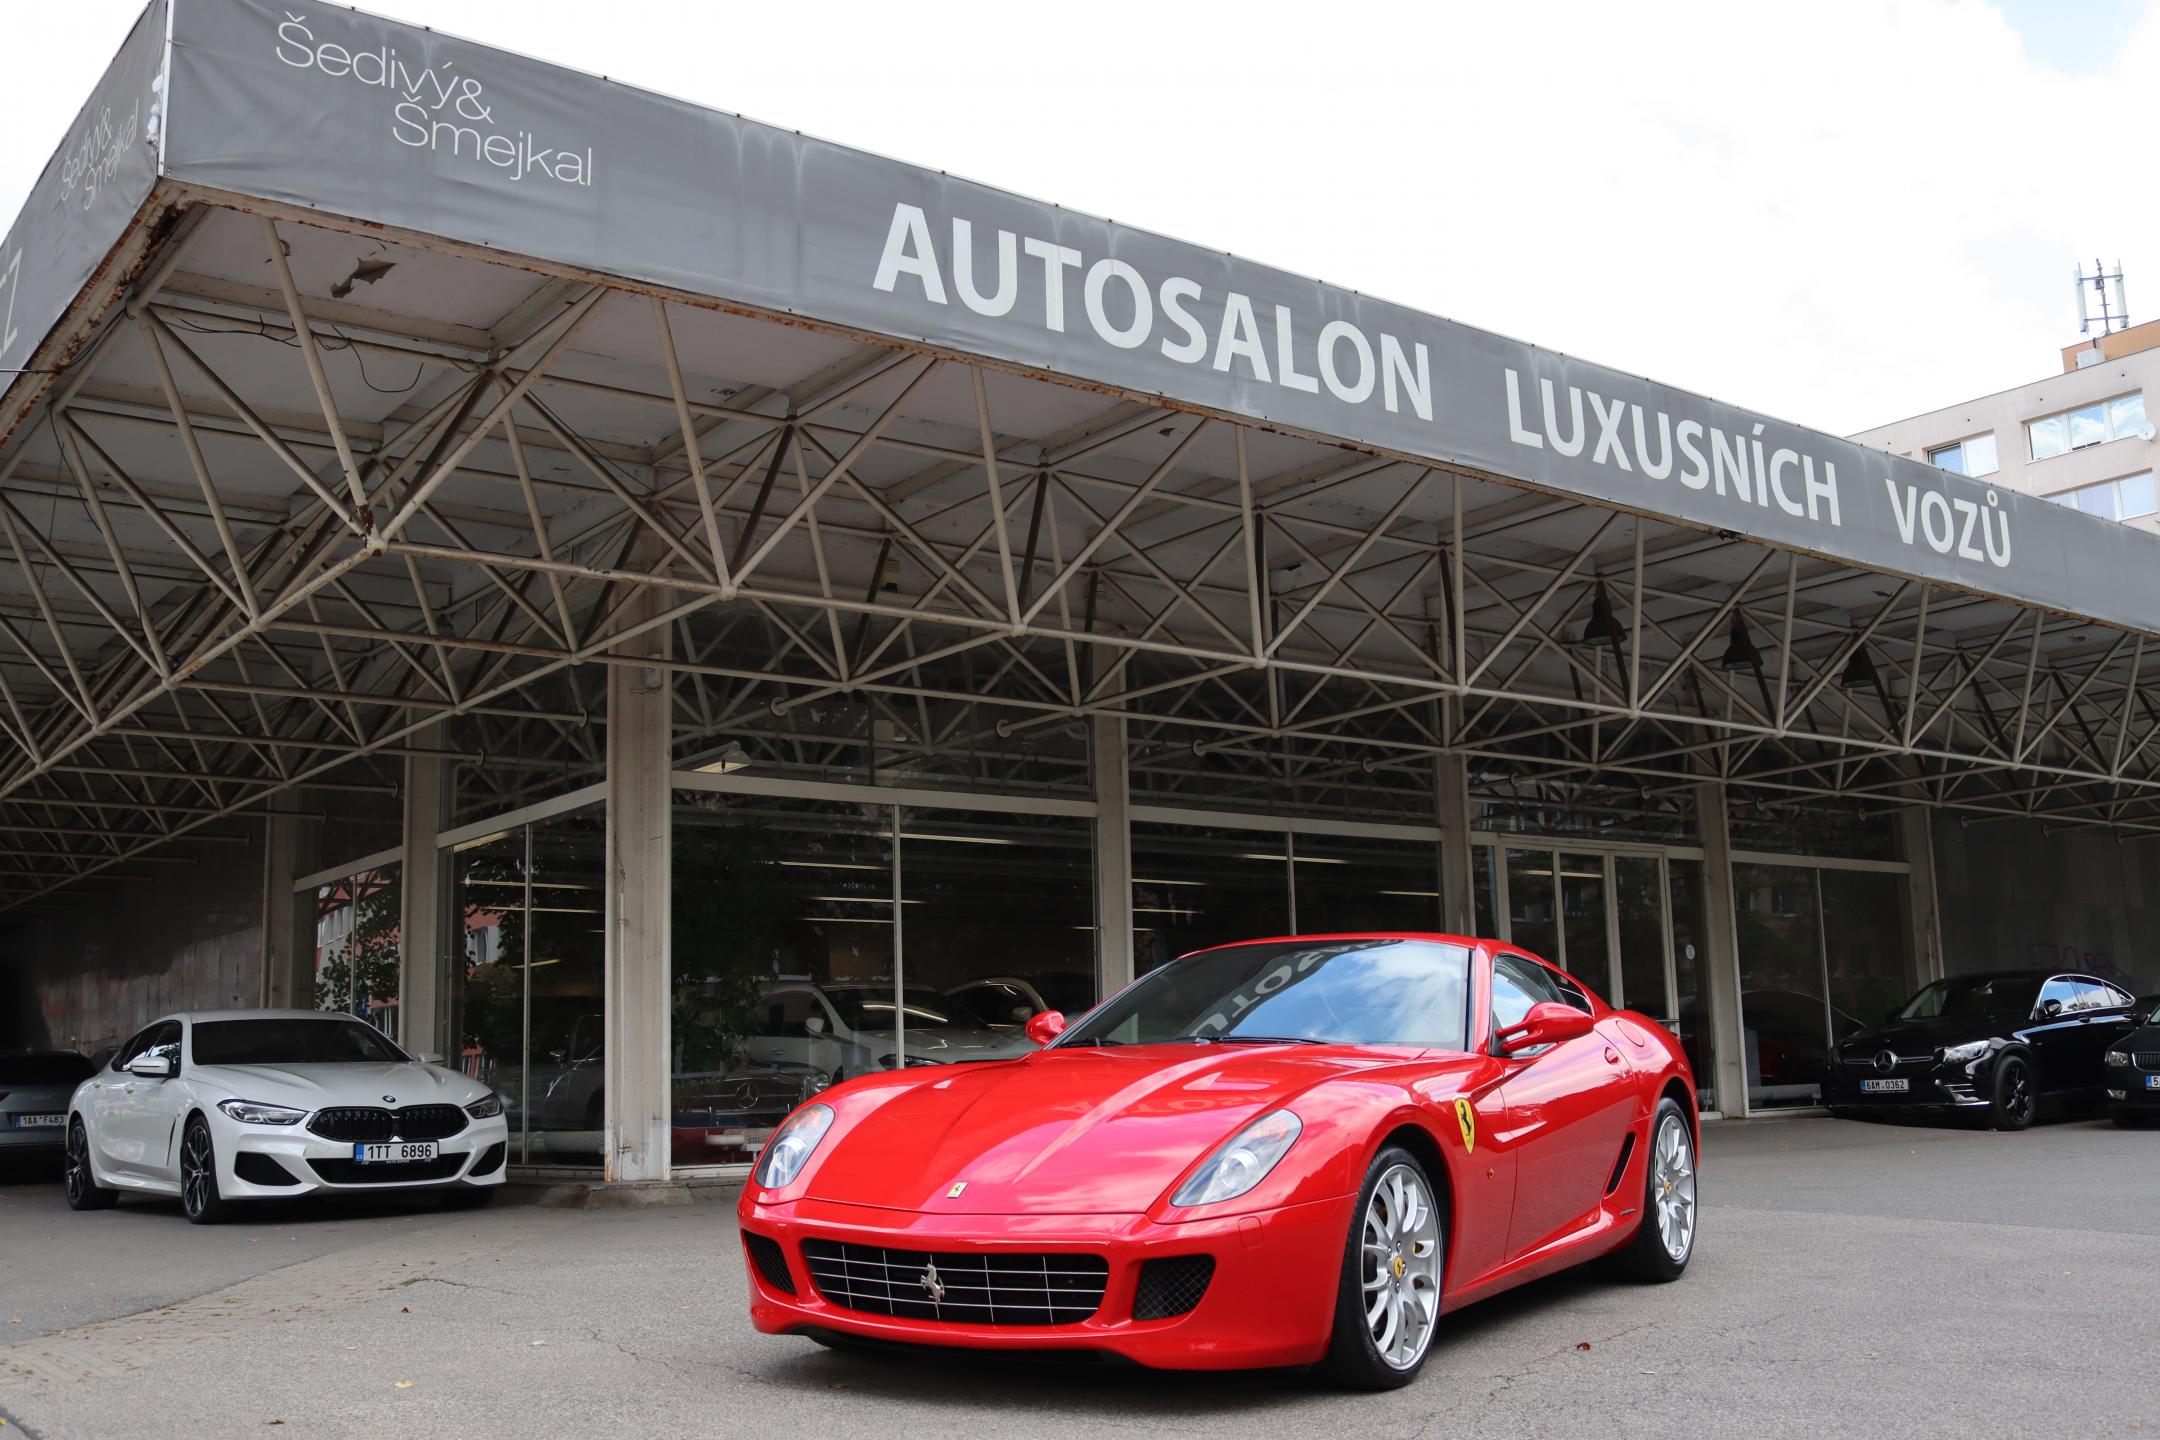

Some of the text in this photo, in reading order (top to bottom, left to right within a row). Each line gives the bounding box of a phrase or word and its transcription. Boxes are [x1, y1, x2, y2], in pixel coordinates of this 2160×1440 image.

[392, 91, 592, 186] Šmejkal
[872, 201, 2012, 568] AUTOSALON LUXUSNÍCH VOZŮ
[1885, 1080, 1904, 1089] 0362
[367, 1144, 432, 1160] 1TT 6896
